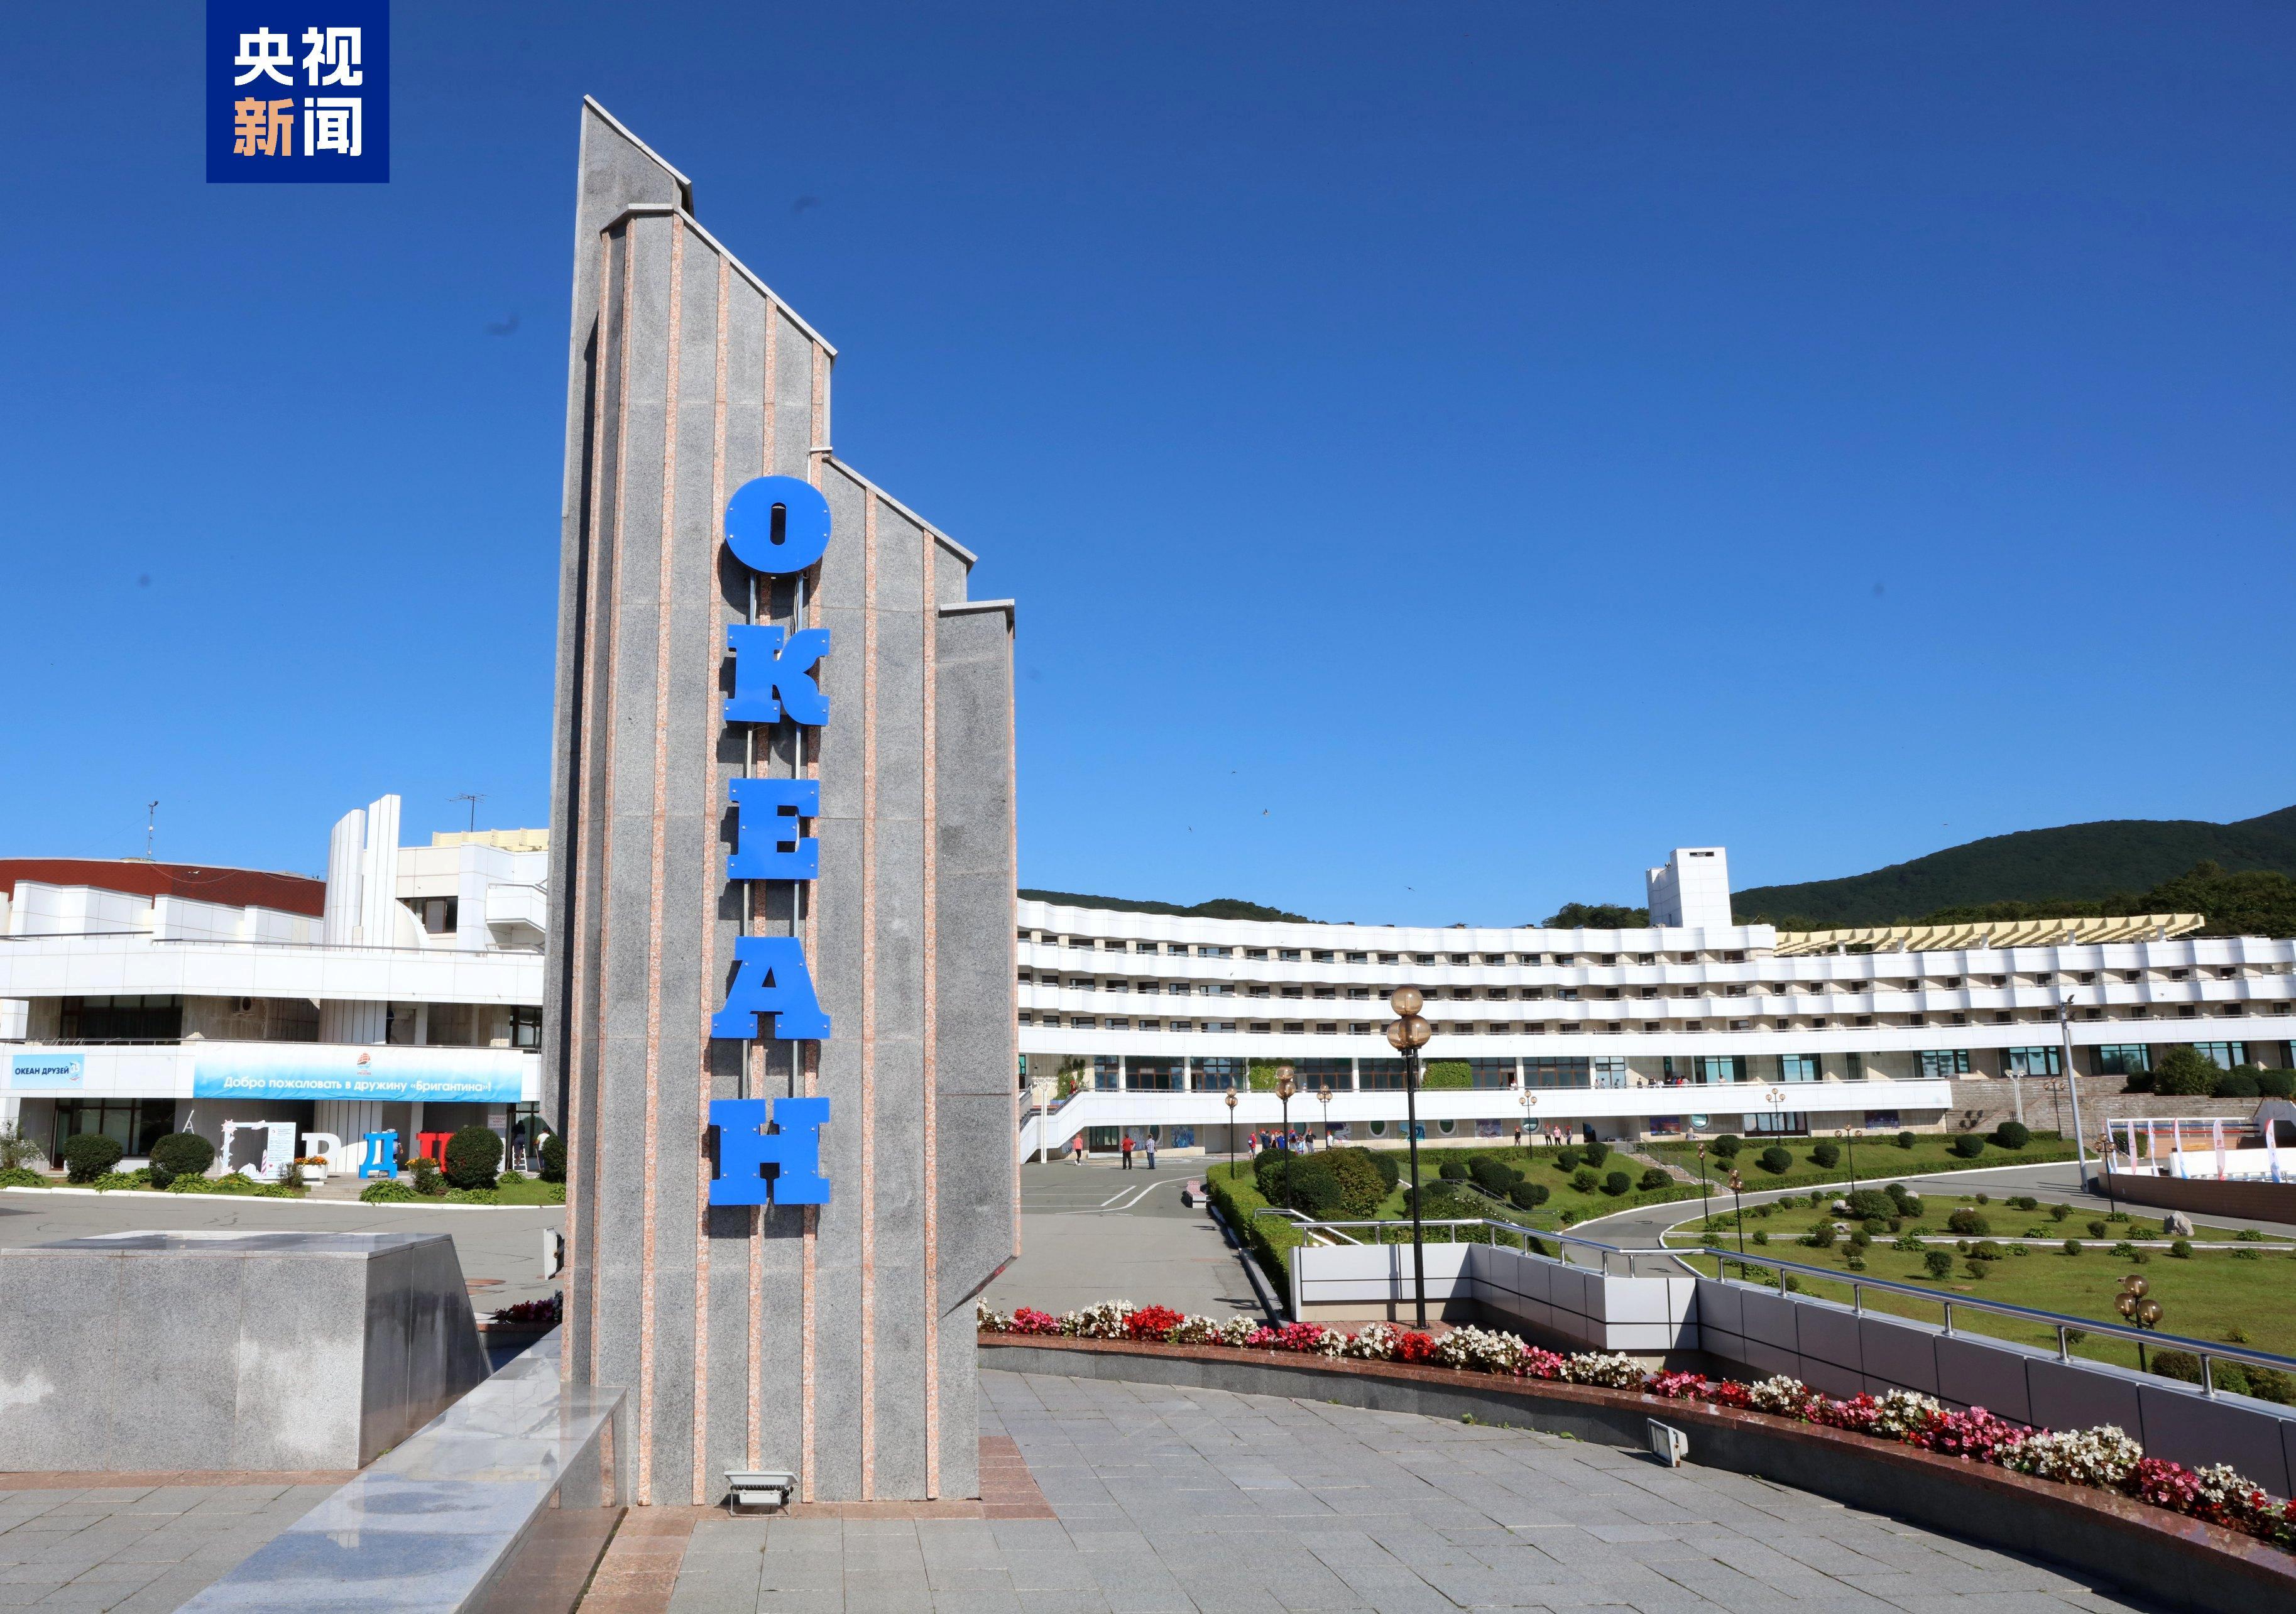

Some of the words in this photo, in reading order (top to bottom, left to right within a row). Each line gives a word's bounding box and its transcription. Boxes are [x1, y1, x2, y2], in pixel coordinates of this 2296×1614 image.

[711, 475, 831, 1205] ОКЕАН
[41, 1066, 69, 1075] ДРУЗЕЙ
[224, 1076, 265, 1089] Добро
[269, 1079, 342, 1089] пожаловать
[354, 1080, 407, 1092] дружину
[410, 1080, 491, 1092] «Бригантина»!
